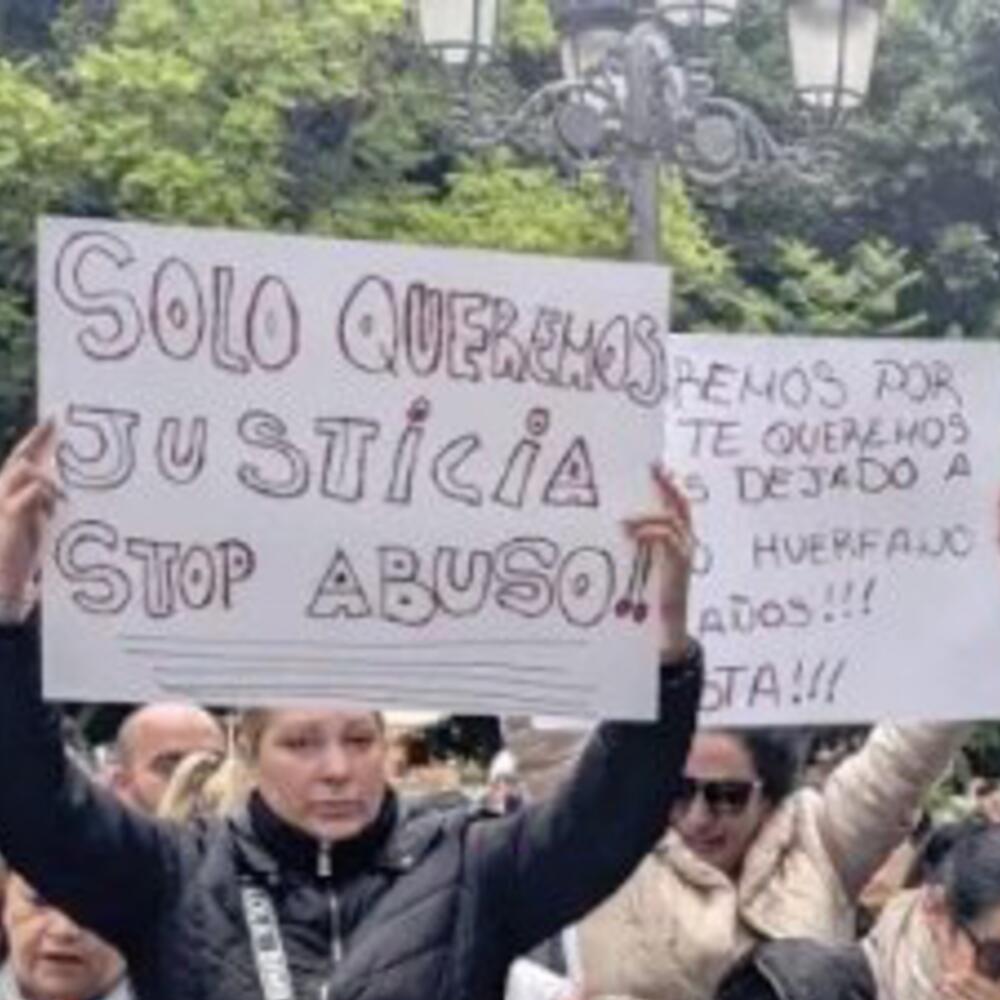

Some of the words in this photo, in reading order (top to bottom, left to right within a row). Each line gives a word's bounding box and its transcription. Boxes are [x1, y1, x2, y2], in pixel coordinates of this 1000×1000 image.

[54, 230, 299, 374] SOLO
[337, 274, 669, 406] QUEREMOS
[873, 358, 963, 407] POR
[678, 417, 740, 458] TE
[761, 412, 970, 456] QUEREMOS
[735, 456, 918, 504] DEJADO
[944, 452, 972, 482] A
[54, 518, 256, 619] STOP
[752, 523, 974, 570] HUERFANO
